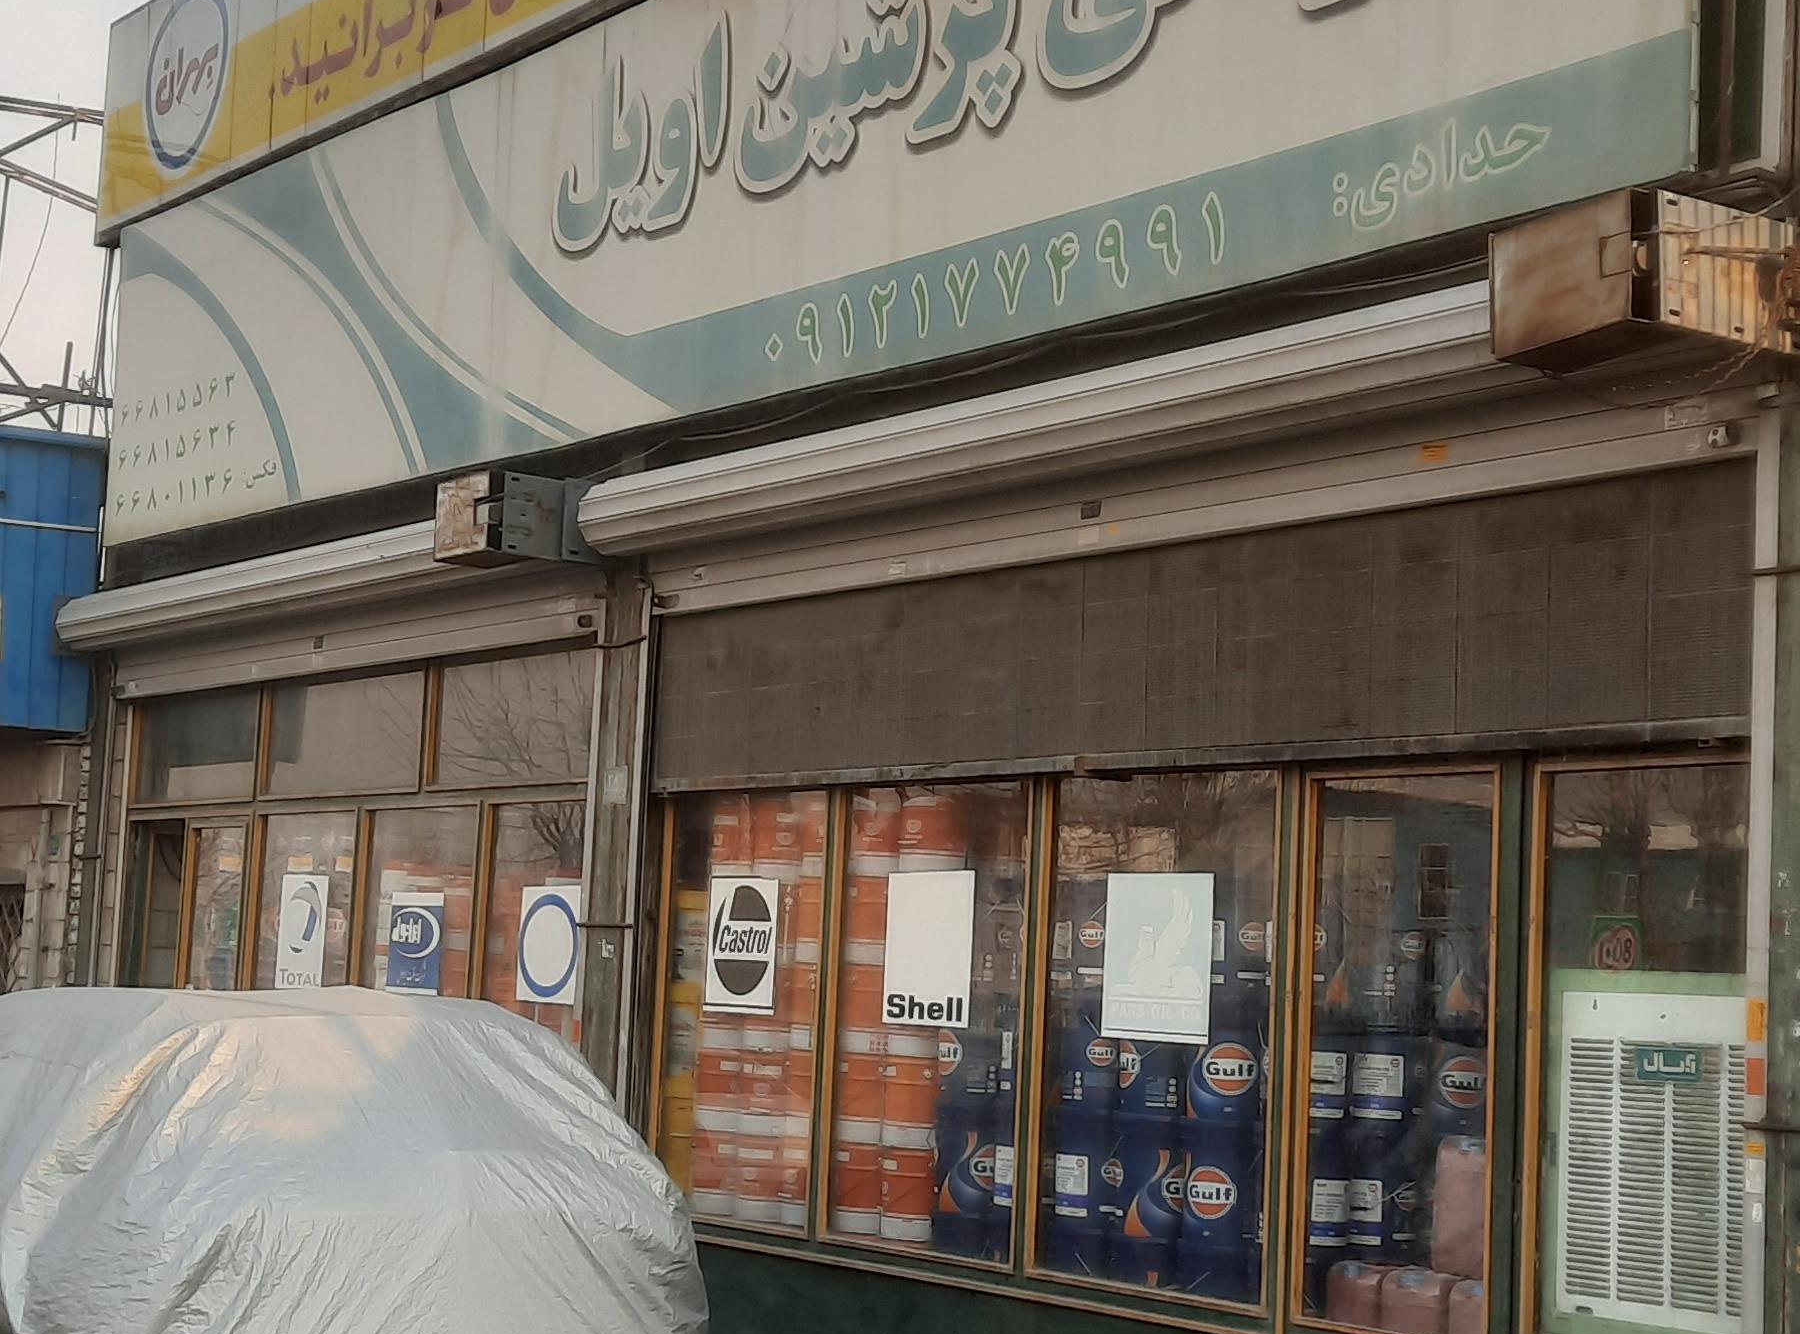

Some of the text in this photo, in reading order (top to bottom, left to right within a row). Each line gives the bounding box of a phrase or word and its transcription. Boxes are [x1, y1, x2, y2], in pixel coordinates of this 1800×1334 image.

[553, 12, 731, 253] اویل
[765, 192, 1225, 363] ۰۹۱۲۱۷۷۴۹۹۱
[121, 372, 236, 426] ۶۶۸۱۵۵۶۳
[118, 420, 236, 470] ۶۶۸۱۵۶۳۴
[115, 468, 234, 516] ۶۶۸۰۱۱۳۶
[719, 924, 773, 954] Castrol
[1080, 929, 1104, 939] Gulf
[886, 993, 963, 1022] Shell
[1088, 1047, 1114, 1057] Gulf
[1206, 1061, 1255, 1077] Gulf
[1189, 1184, 1233, 1200] Gulf
